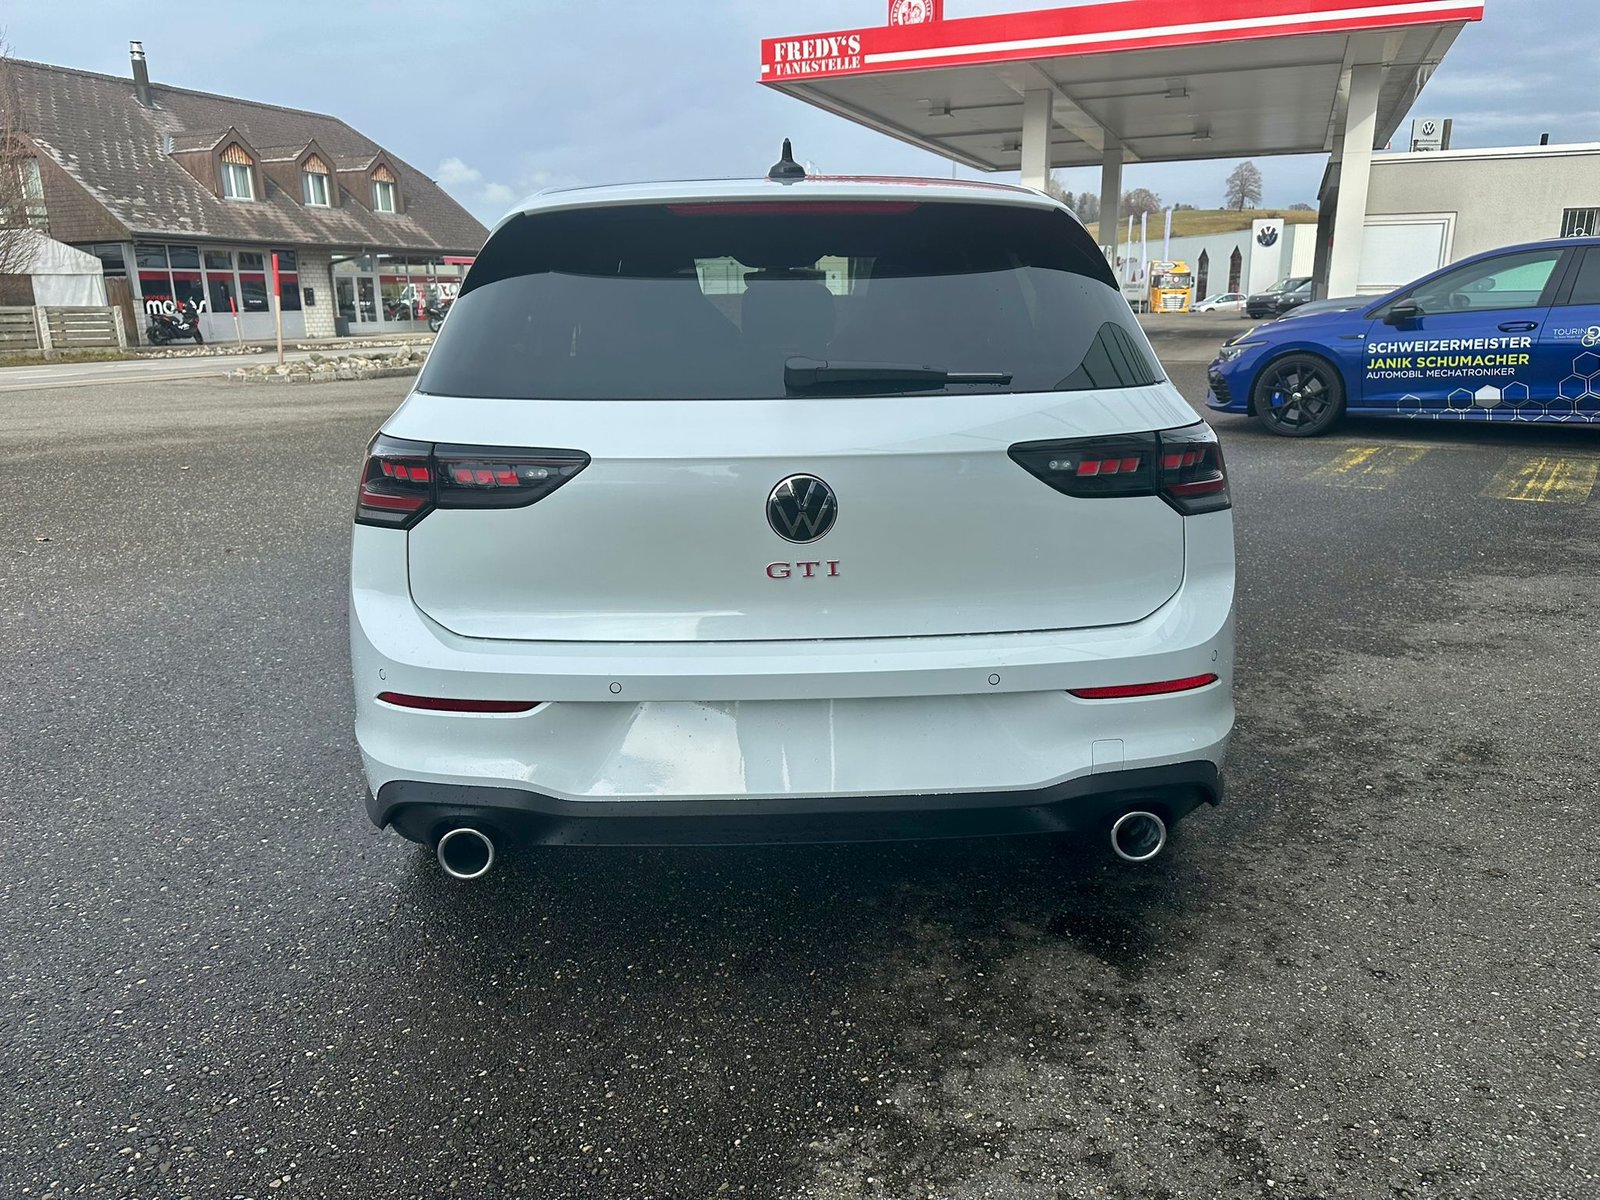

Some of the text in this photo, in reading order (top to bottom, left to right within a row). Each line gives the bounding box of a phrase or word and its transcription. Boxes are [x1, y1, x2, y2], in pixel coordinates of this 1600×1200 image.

[774, 35, 861, 62] FREDY'S
[774, 56, 861, 76] TANKSTELLE
[1367, 336, 1532, 354] SCHWEIZERMEISTER
[1367, 353, 1530, 369] JANIK SCHUMACHER
[1366, 367, 1516, 379] AUTOMOBIL MECHATRONIKER
[766, 560, 840, 579] GTI
